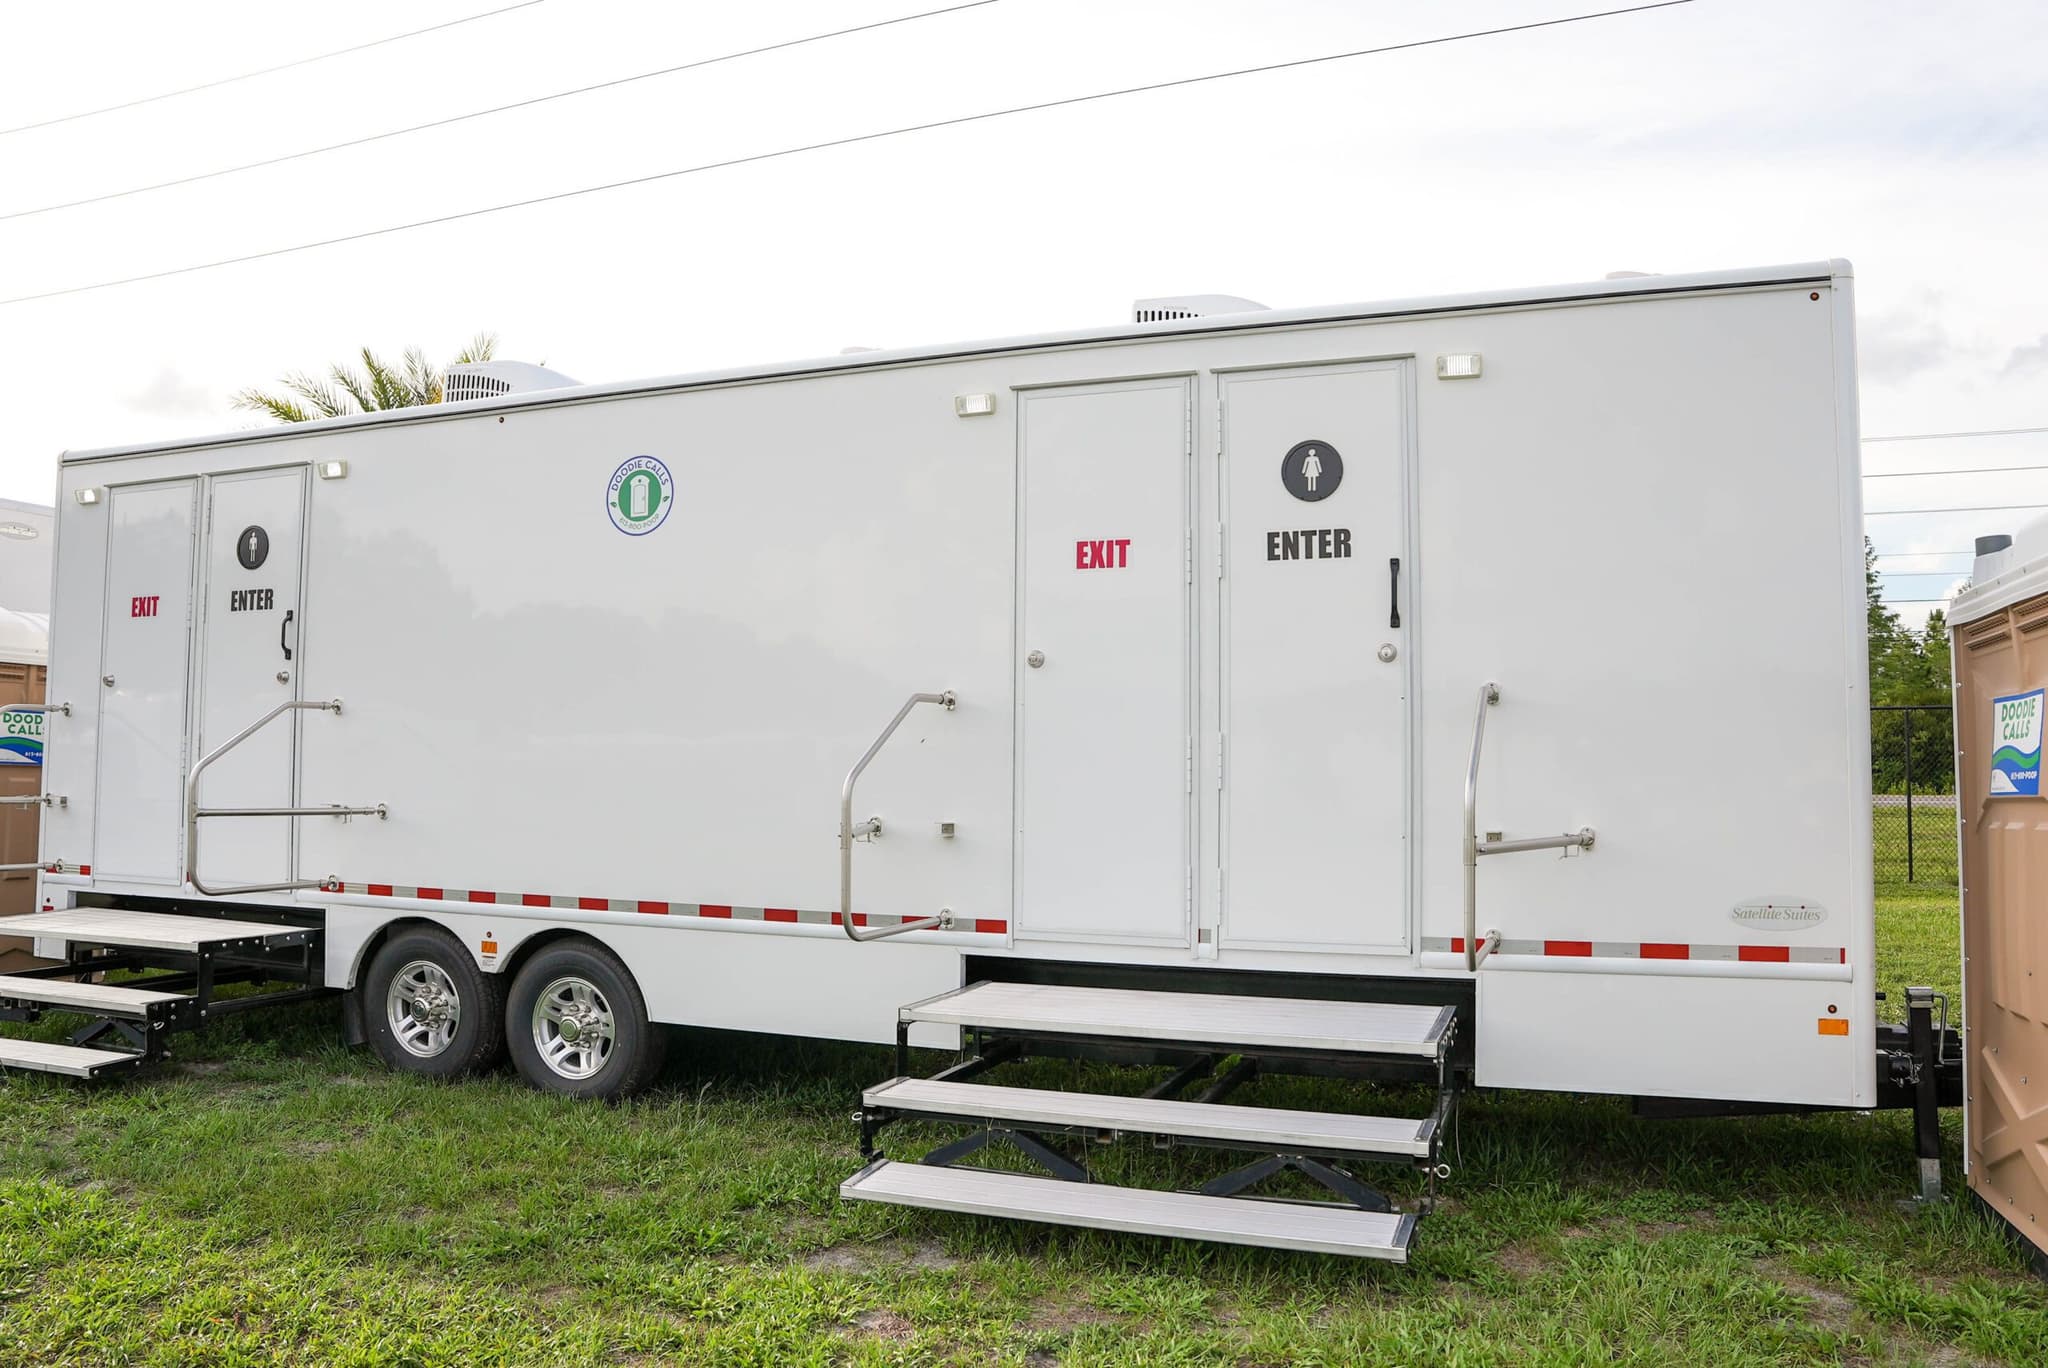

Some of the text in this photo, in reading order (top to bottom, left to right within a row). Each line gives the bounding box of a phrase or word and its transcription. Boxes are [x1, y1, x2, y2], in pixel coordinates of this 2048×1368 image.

[611, 460, 669, 491] DOODIE CALLS
[1076, 538, 1132, 570] EXIT
[1266, 528, 1352, 562] ENTER
[131, 595, 160, 618] EXIT
[230, 588, 274, 612] ENTER
[2001, 698, 2036, 722] DOODIE
[2003, 720, 2031, 741] CALLS
[1731, 907, 1822, 921] Satellite Suites
